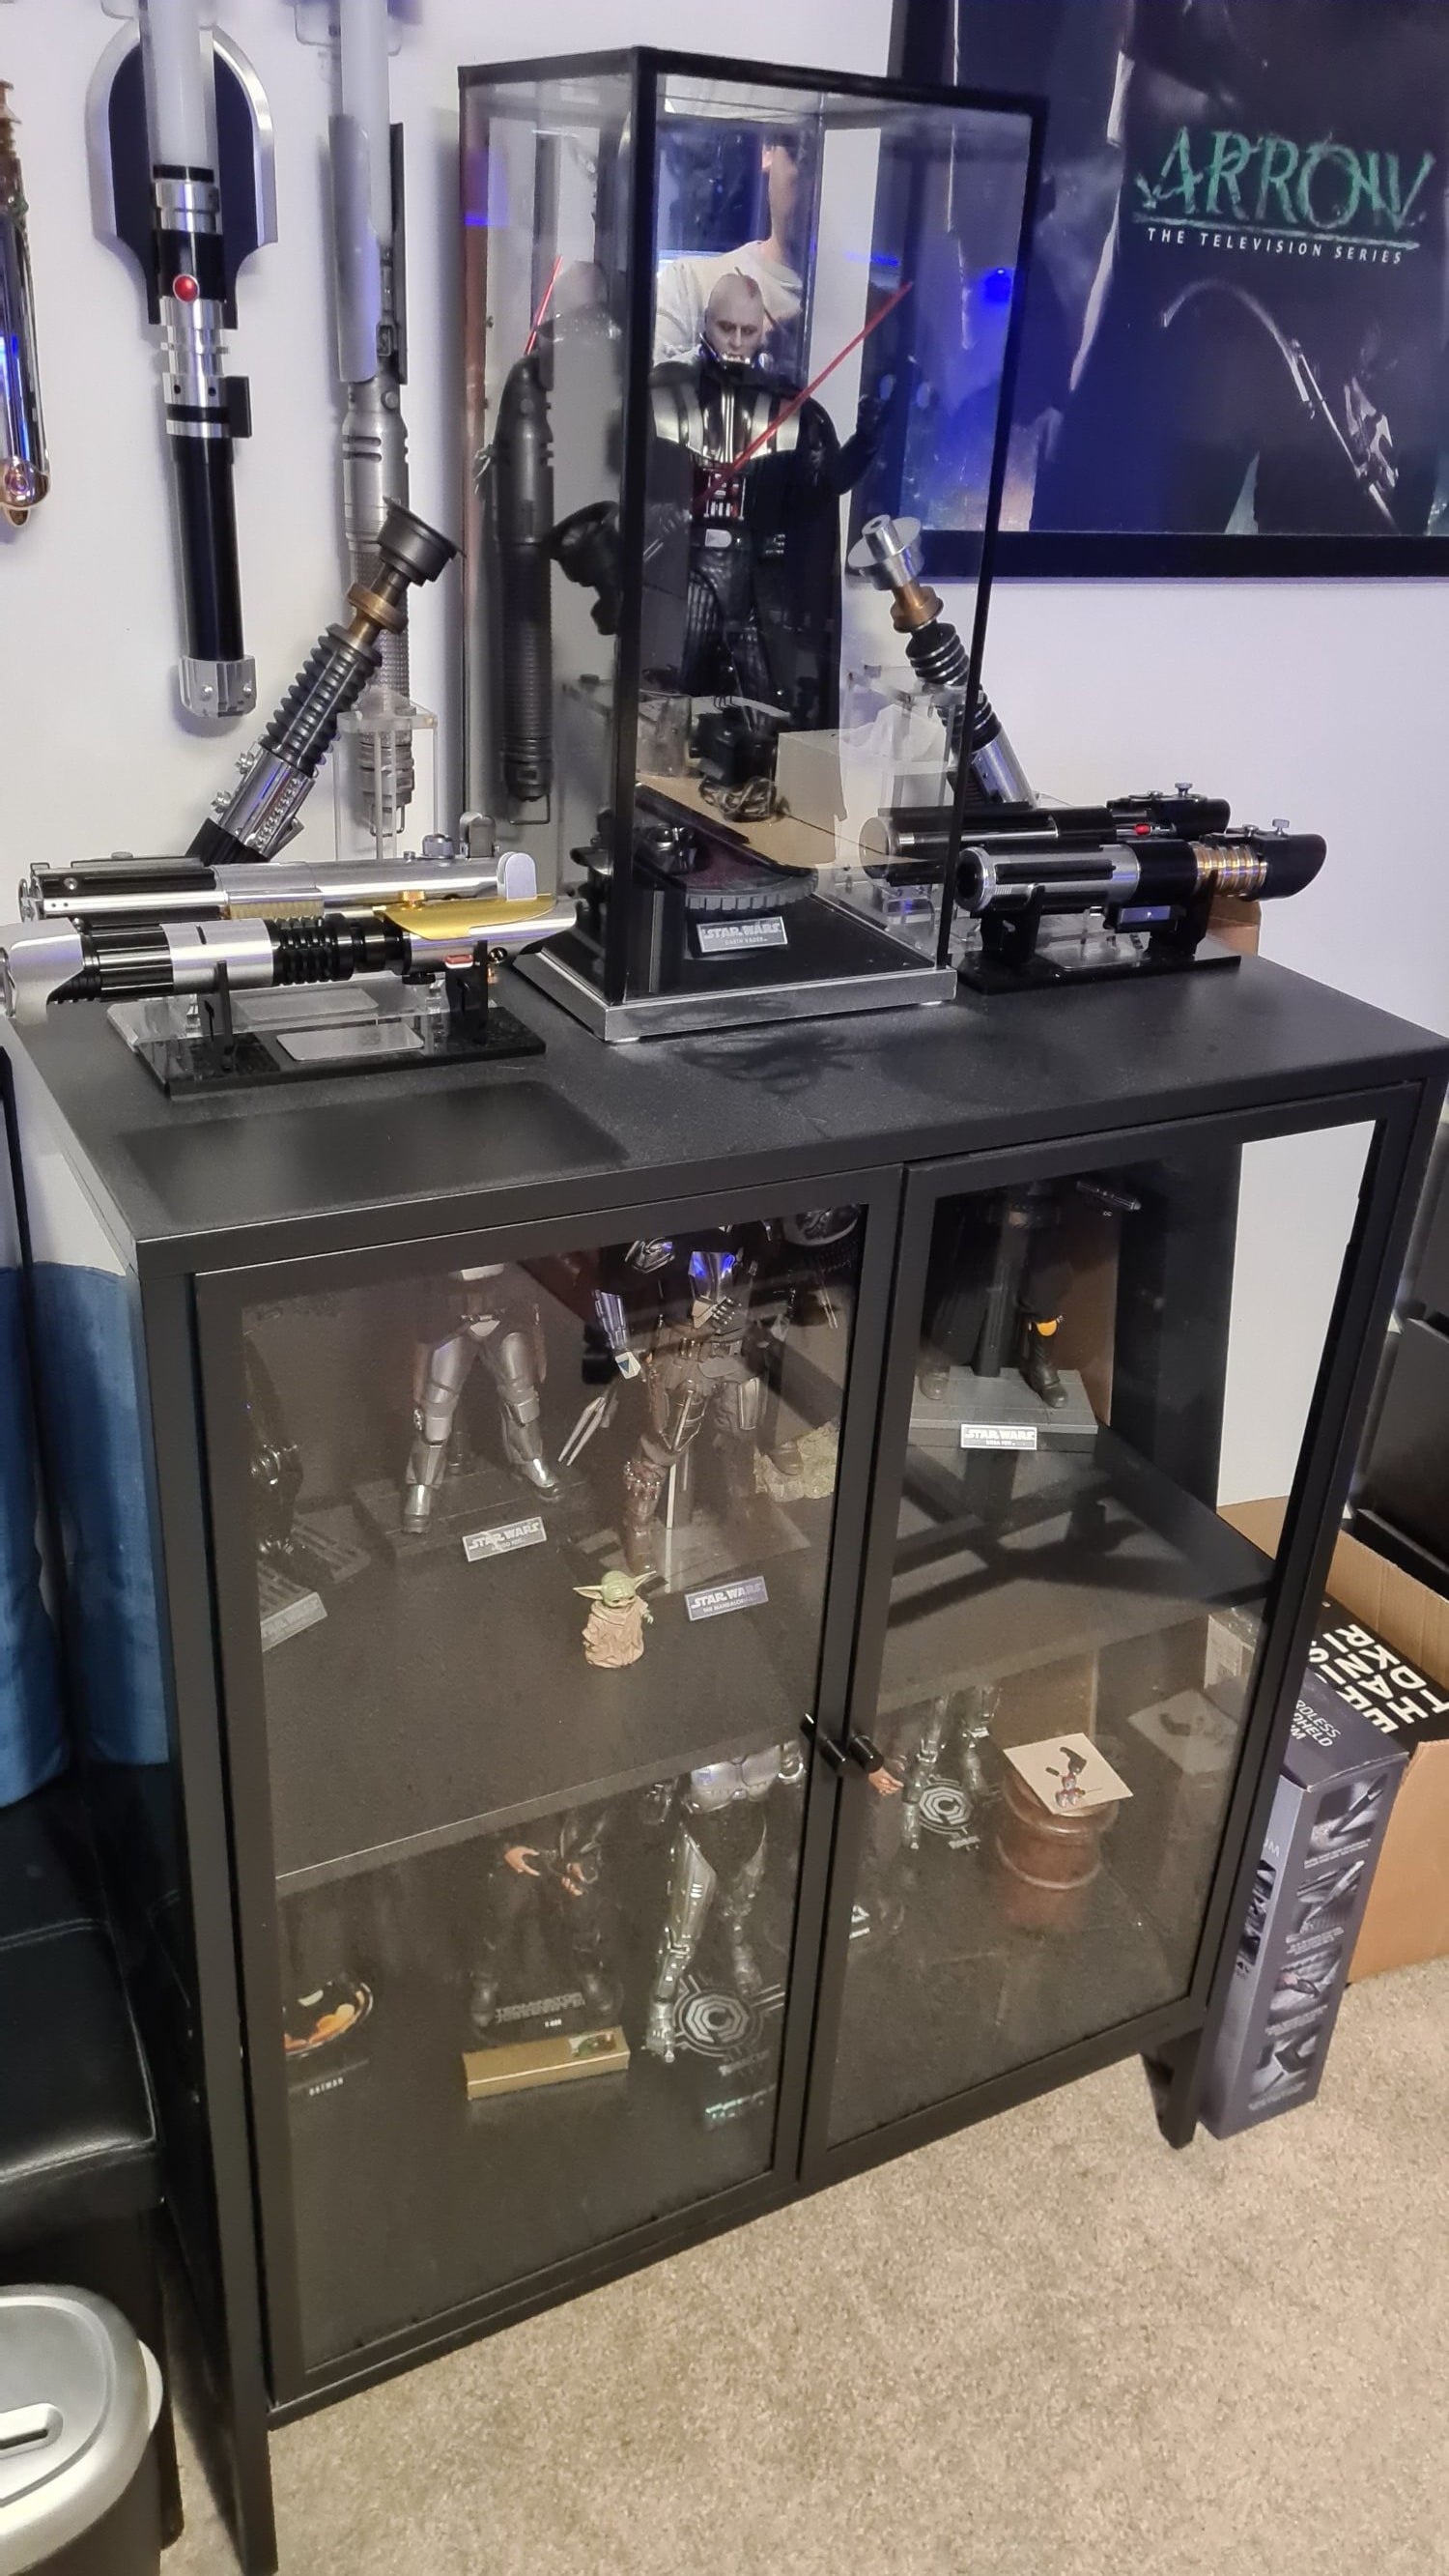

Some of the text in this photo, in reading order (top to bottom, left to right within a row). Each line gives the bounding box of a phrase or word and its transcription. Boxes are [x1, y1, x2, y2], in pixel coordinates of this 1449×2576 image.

[1135, 127, 1435, 232] ARROW
[1148, 227, 1403, 265] THE TELEVISION SERIES
[703, 923, 782, 939] STAR WARS
[965, 1430, 1036, 1441] STAR WARS
[469, 1533, 504, 1550] STAR
[503, 1523, 539, 1539] WARS
[691, 1583, 762, 1609] STAR WARS
[1309, 1624, 1376, 1663] RIS
[1314, 1645, 1401, 1685] KNI
[1336, 1665, 1427, 1710] DAR
[1293, 1712, 1333, 1746] DHELD
[1296, 1700, 1341, 1737] RDLESS
